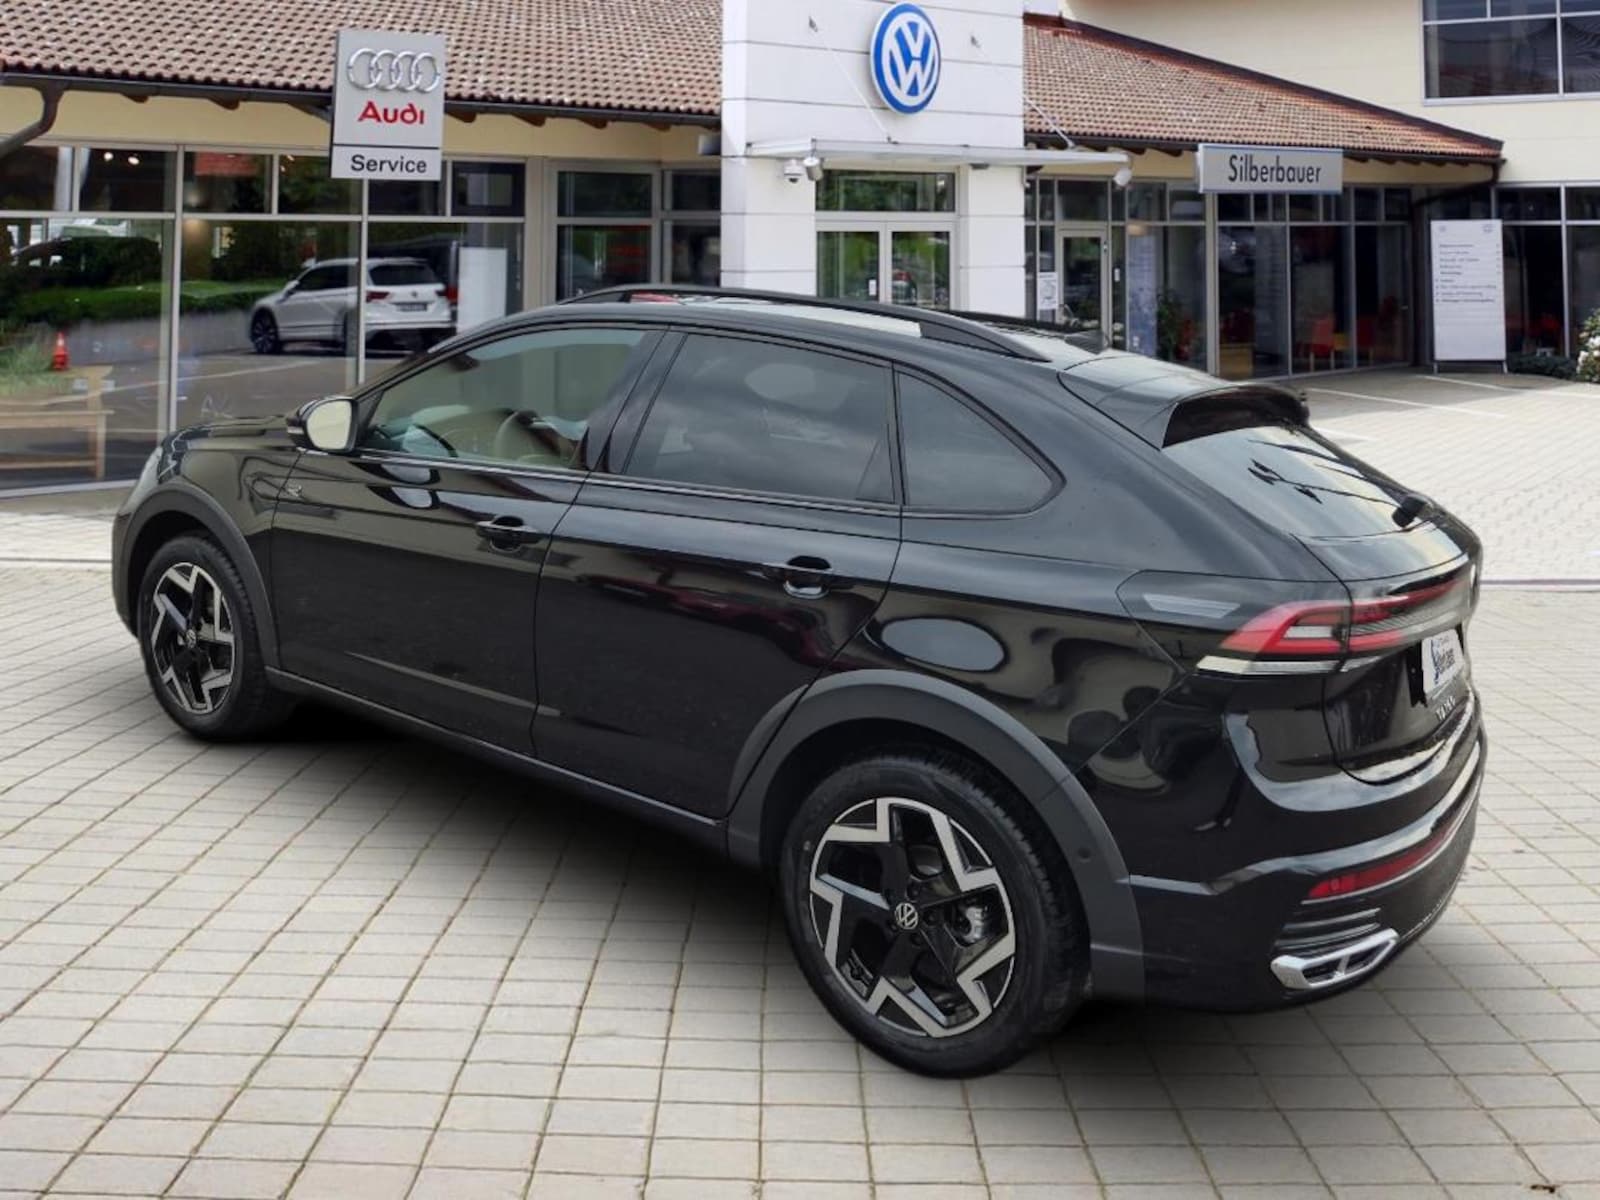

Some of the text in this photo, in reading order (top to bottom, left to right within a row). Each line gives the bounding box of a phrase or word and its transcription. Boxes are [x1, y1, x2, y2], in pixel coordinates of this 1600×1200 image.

[875, 5, 940, 111] VW
[357, 100, 425, 125] Audi
[351, 154, 427, 173] Service
[1228, 154, 1322, 182] Silberbauer
